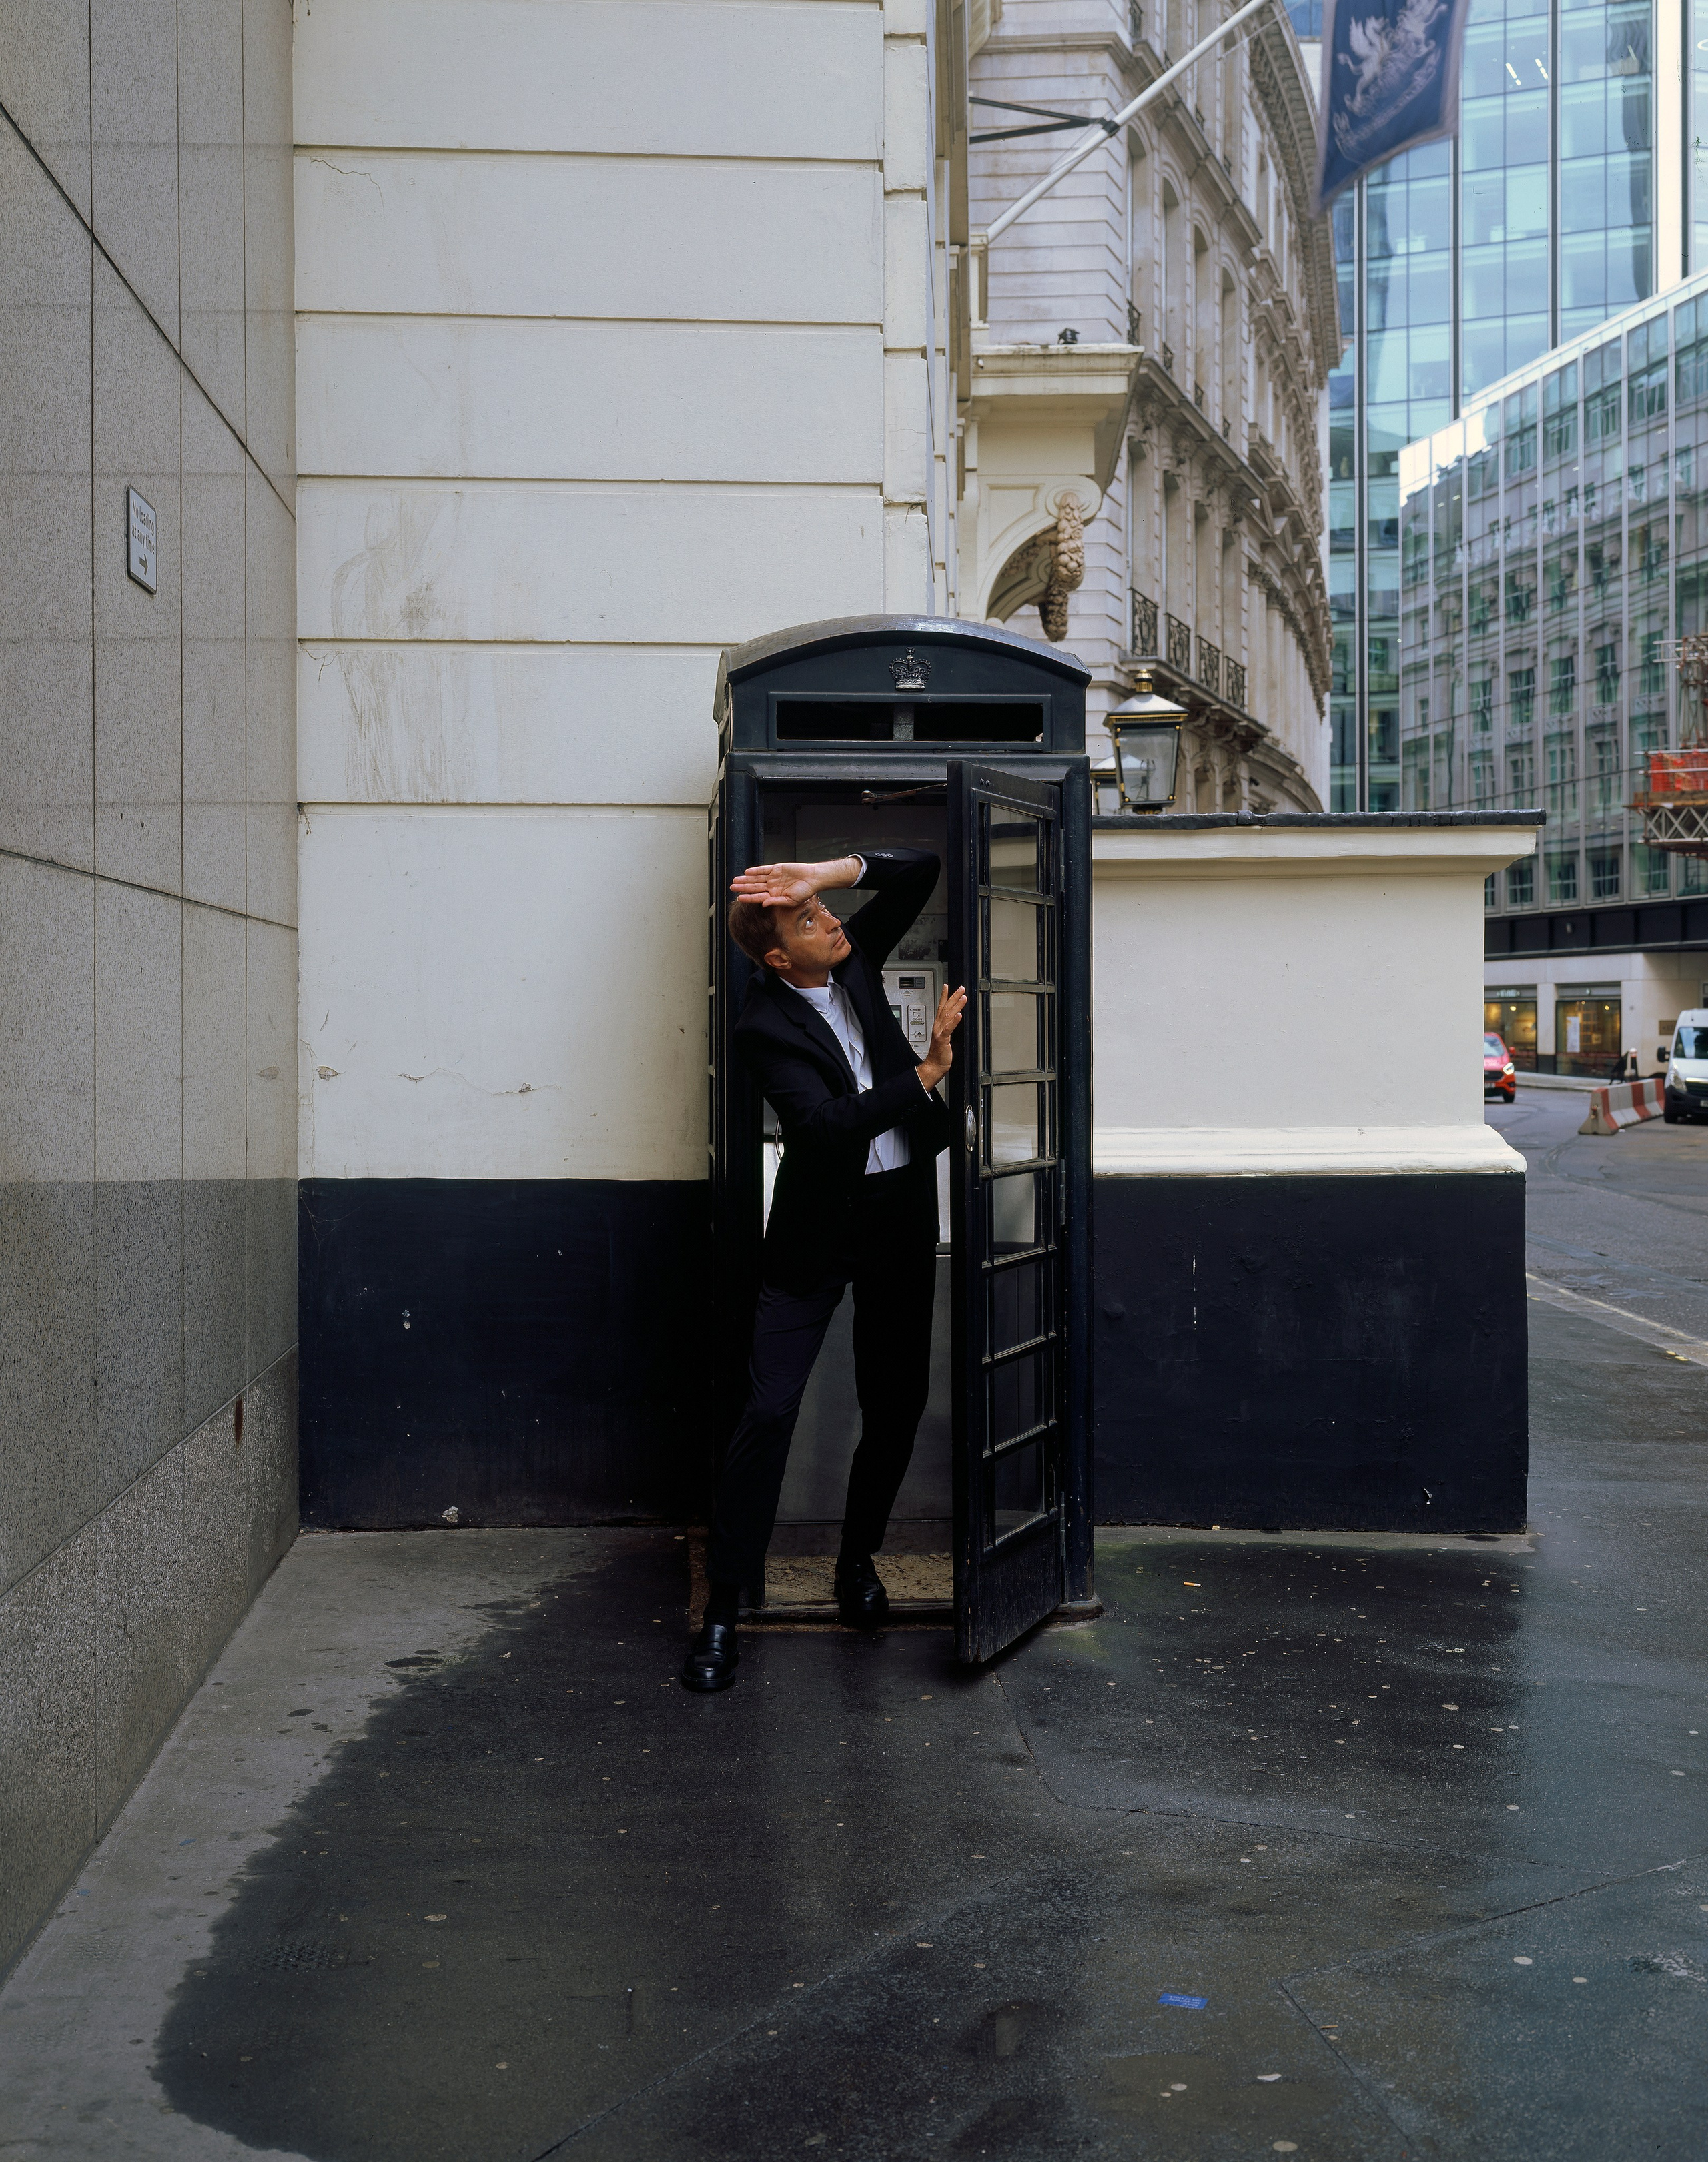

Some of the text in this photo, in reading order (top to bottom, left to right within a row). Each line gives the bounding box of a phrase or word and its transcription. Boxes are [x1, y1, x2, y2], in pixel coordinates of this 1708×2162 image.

[132, 498, 154, 537] No loading
[132, 522, 137, 539] at
[145, 534, 155, 555] time
